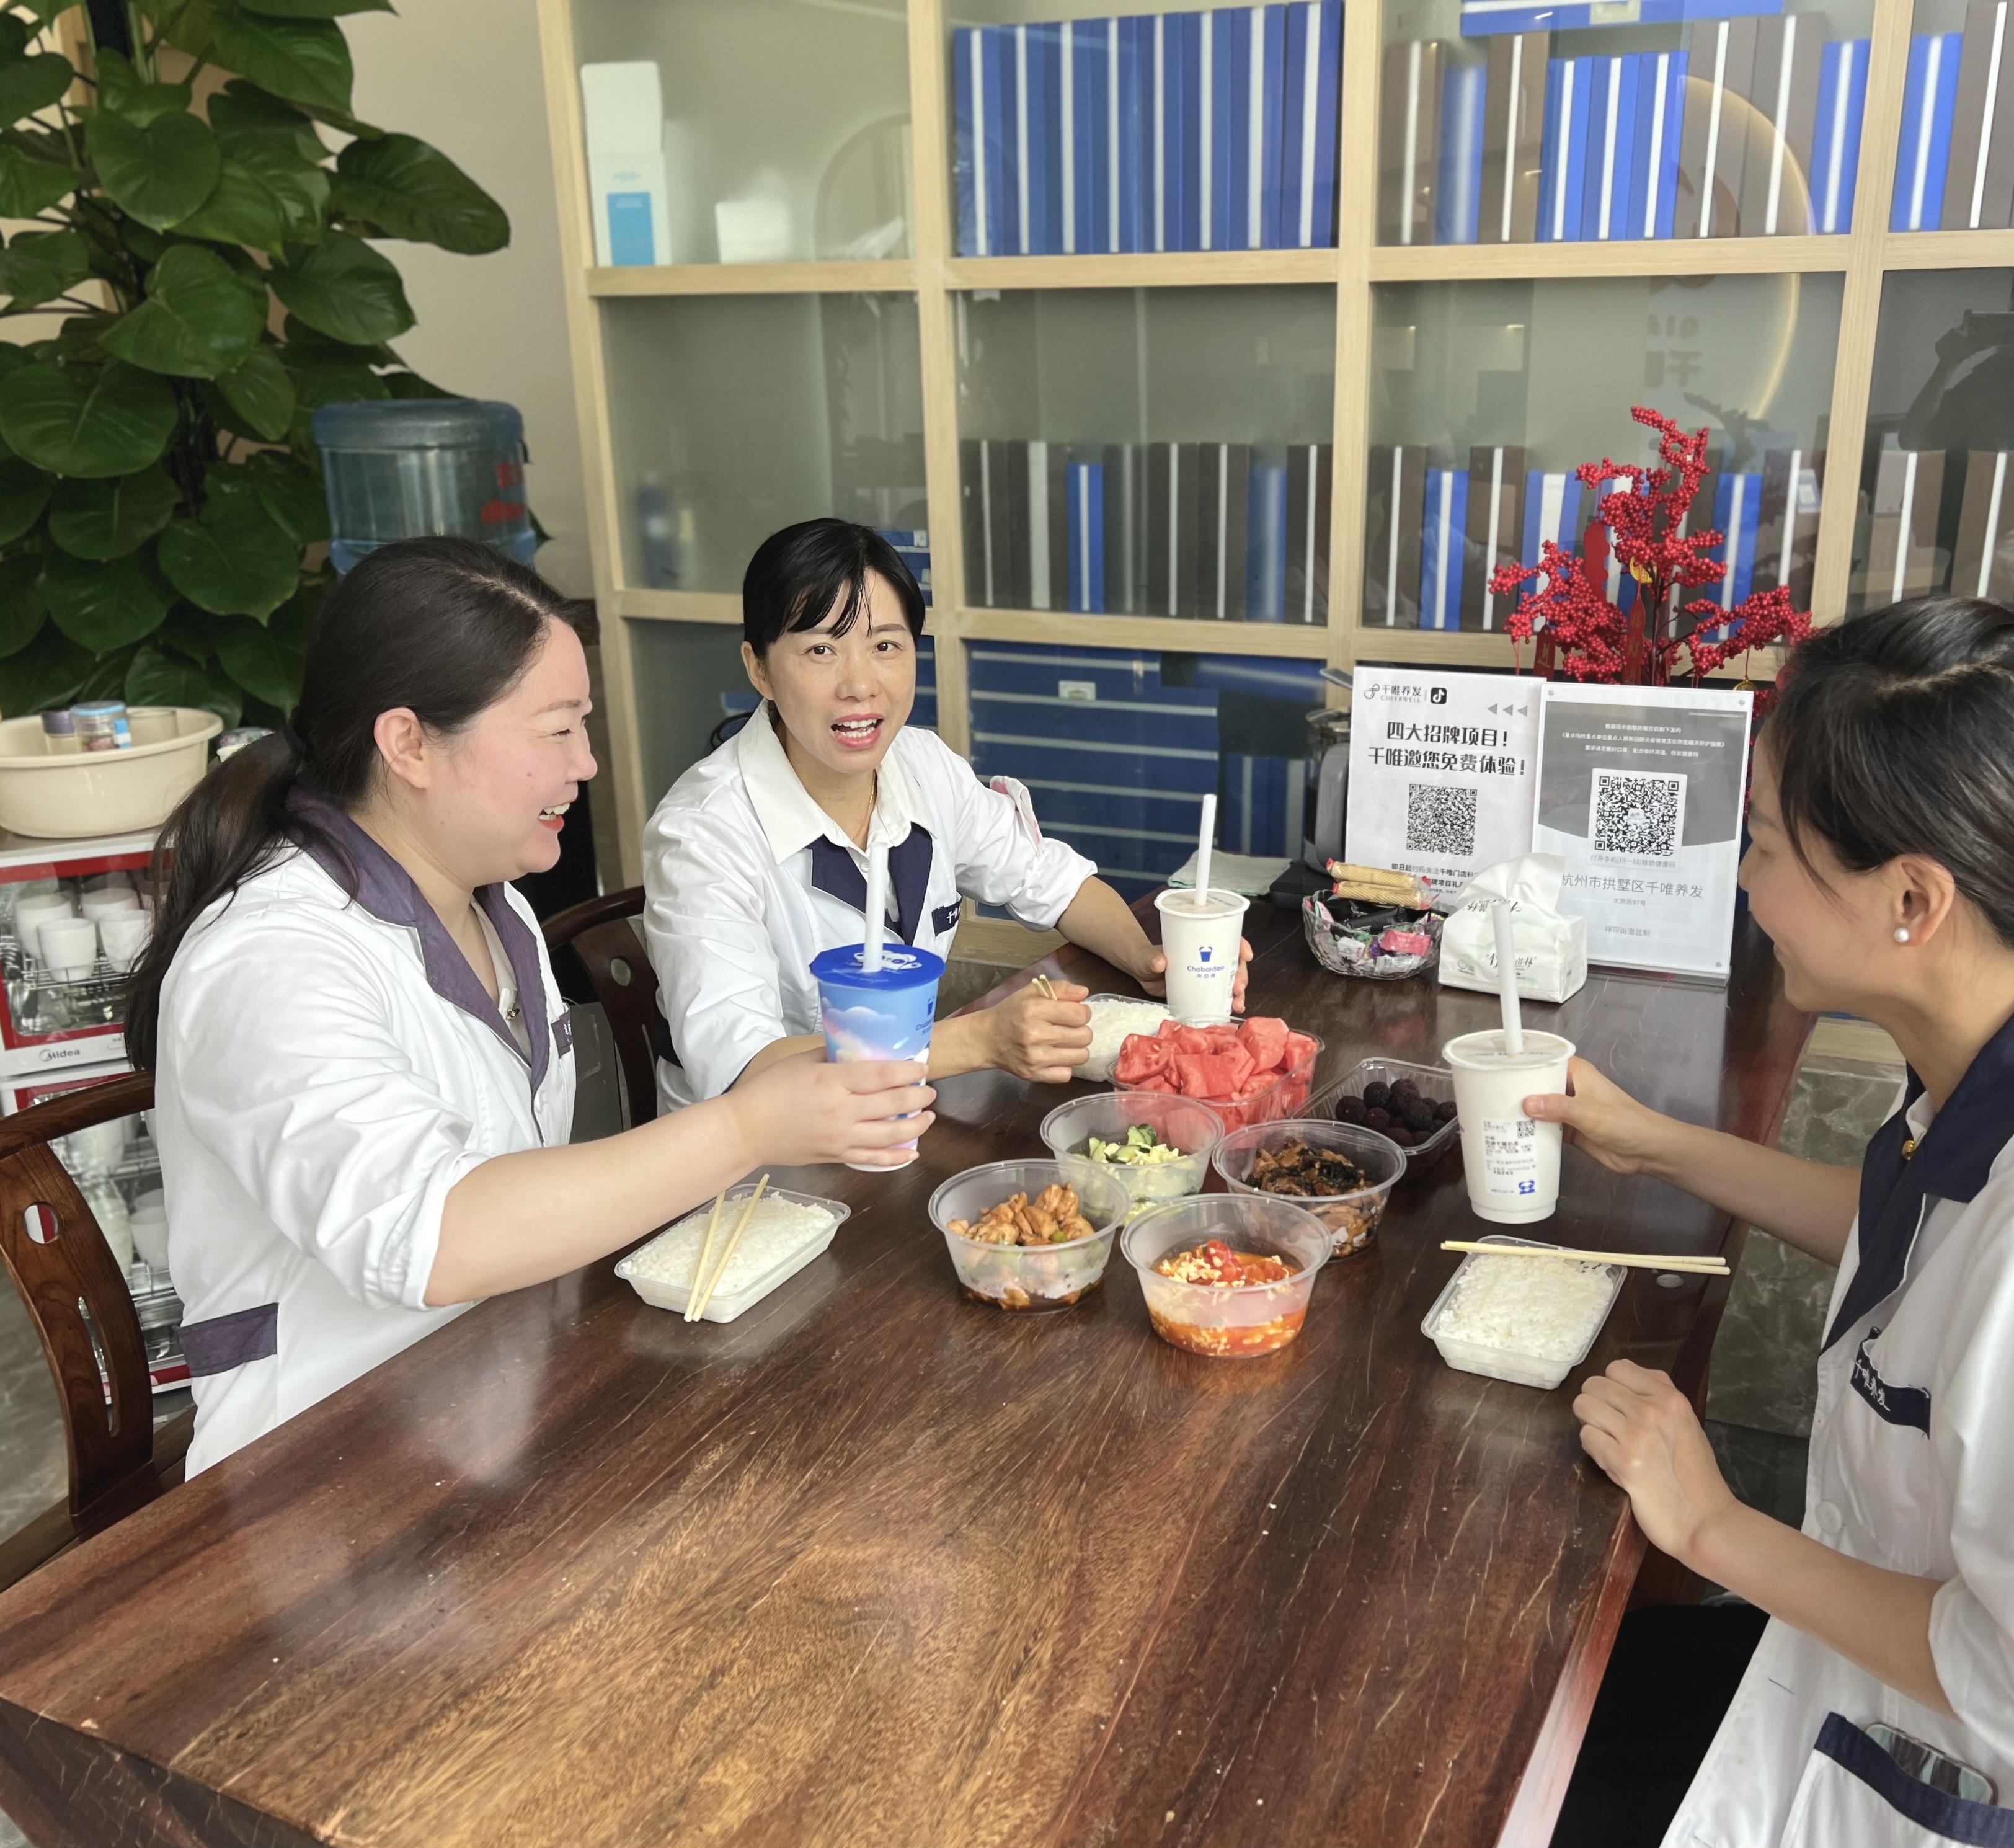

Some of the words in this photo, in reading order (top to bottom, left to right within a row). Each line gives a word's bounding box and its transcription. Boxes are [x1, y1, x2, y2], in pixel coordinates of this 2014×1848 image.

[1381, 684, 1421, 697] 千唯养发
[1391, 863, 1478, 879] 即日起扫码关注千唯门店扫
[1426, 878, 1464, 888] 牌项目礼
[1561, 873, 1704, 899] 杭州市拱墅区千唯养发
[47, 1049, 81, 1060] Midea
